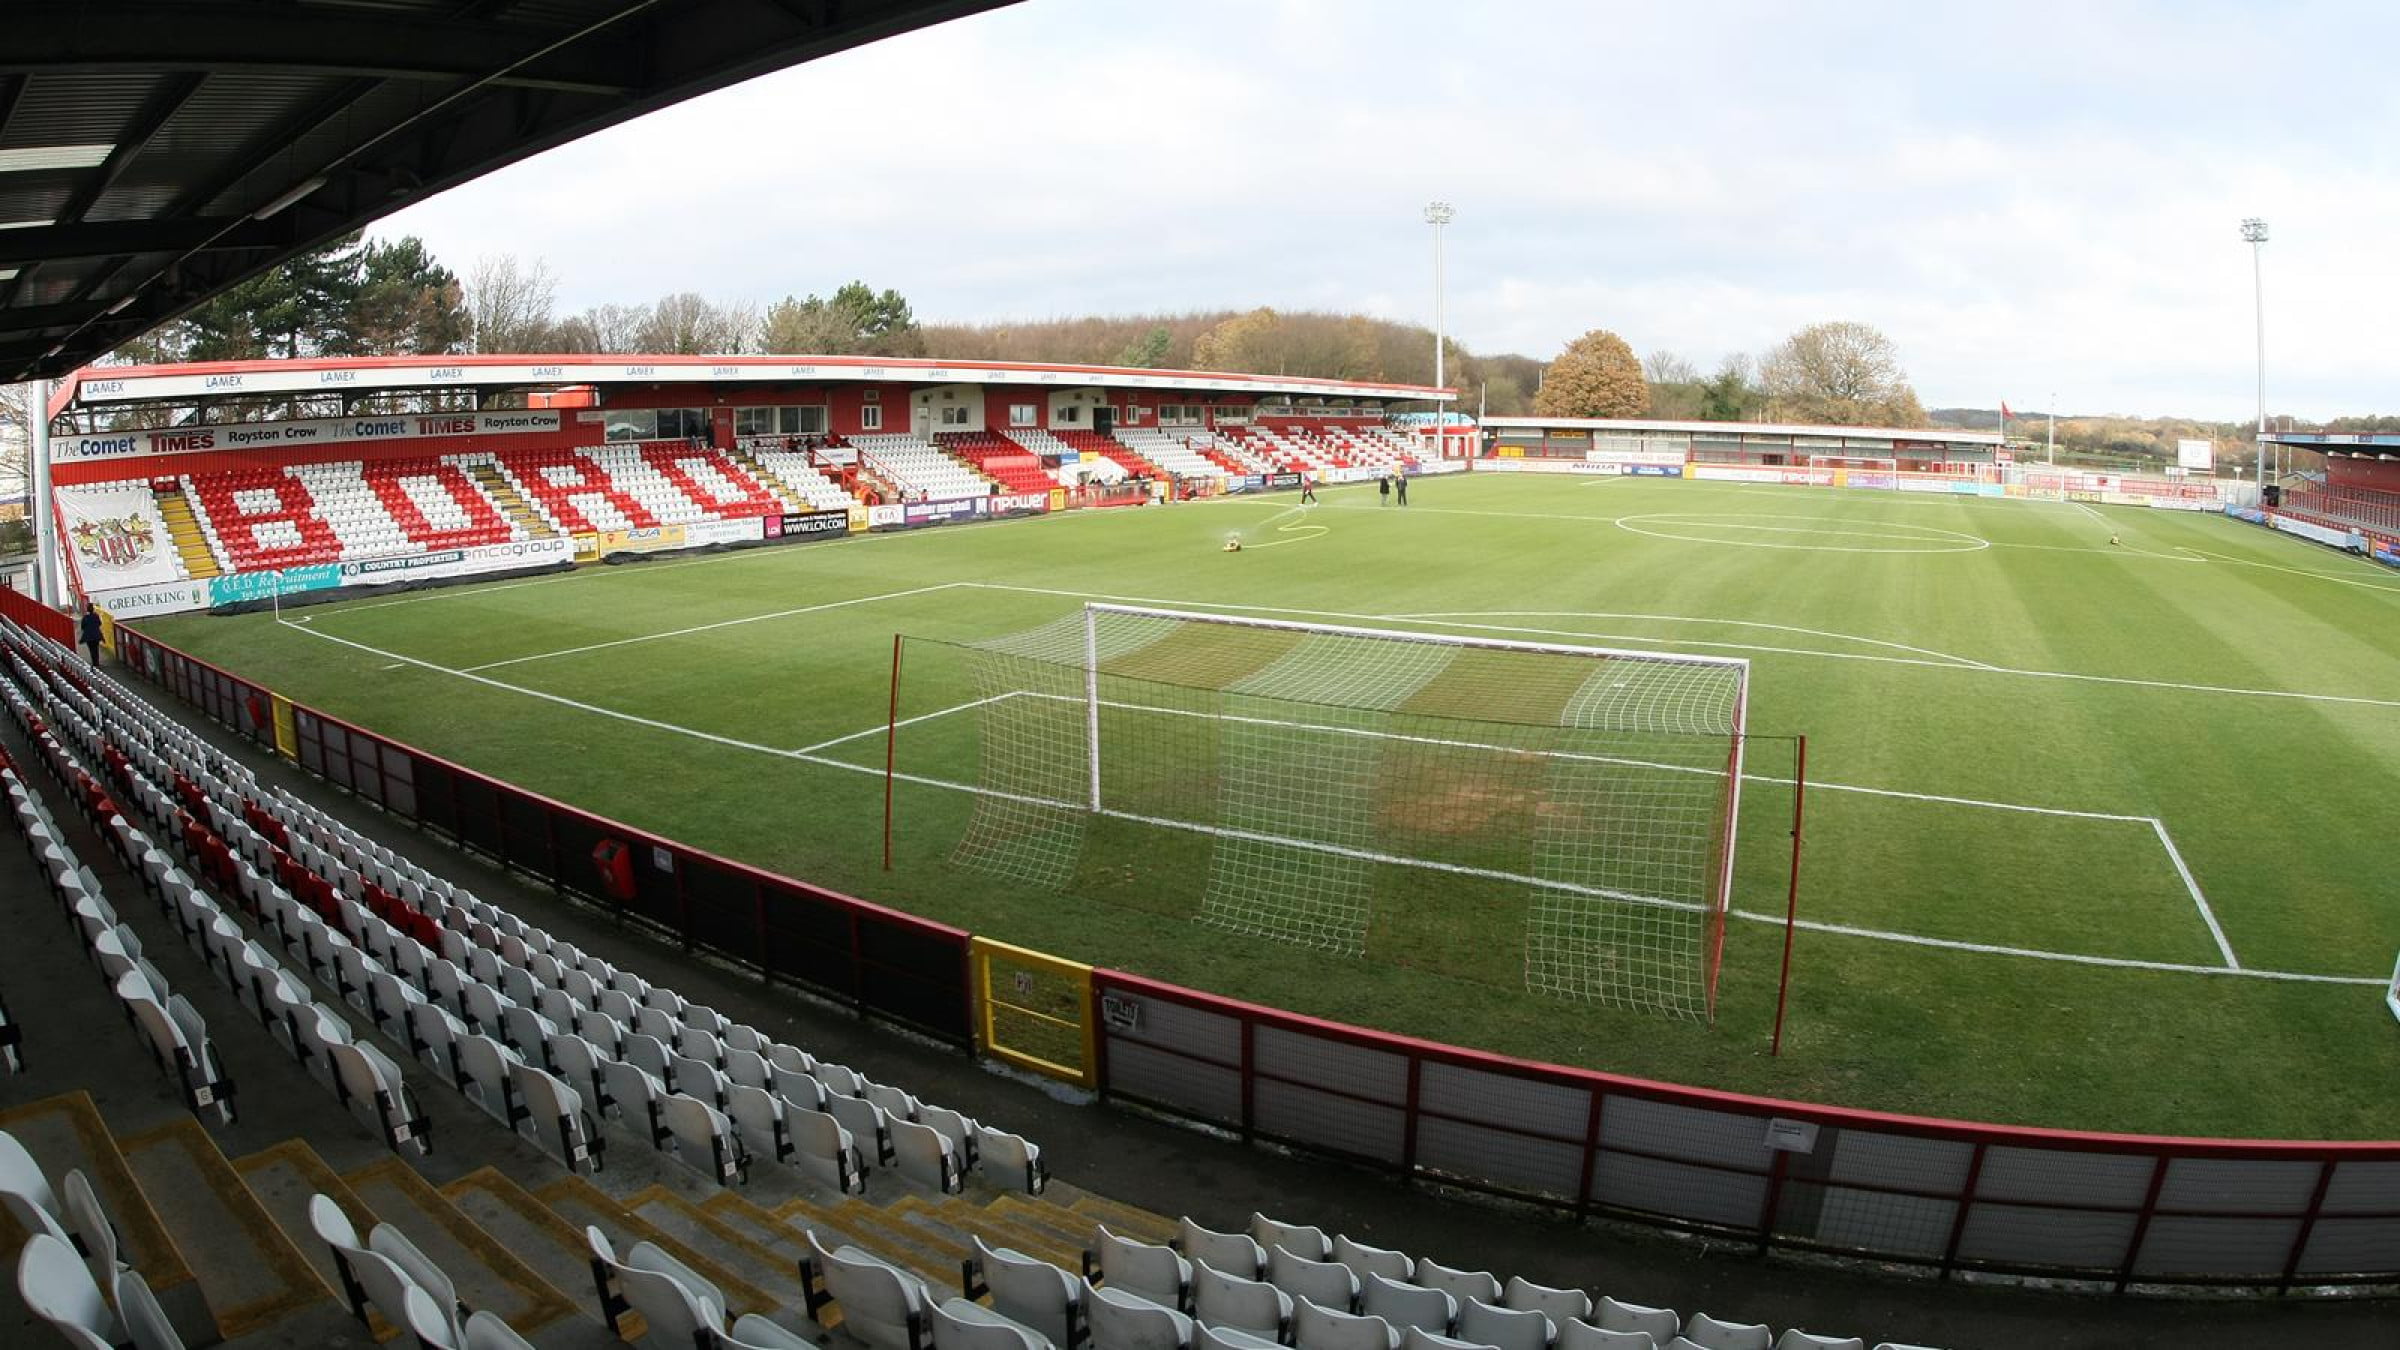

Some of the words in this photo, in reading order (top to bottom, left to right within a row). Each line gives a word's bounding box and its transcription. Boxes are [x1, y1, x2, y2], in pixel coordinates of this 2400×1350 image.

[320, 371, 356, 383] LAMEX
[431, 368, 463, 379] LAMEX
[532, 367, 562, 377] LAMEX
[626, 366, 654, 376] LAMEX
[713, 366, 739, 376] LAMEX
[791, 365, 816, 375] LAMEX
[87, 381, 124, 395] LAMEX
[206, 376, 242, 388] LAMEX
[331, 422, 356, 438] The
[355, 419, 406, 436] Comet
[415, 416, 476, 434] TIMES
[485, 417, 529, 429] Royston
[530, 416, 558, 426] Crow
[147, 431, 215, 452] TIMES
[229, 430, 280, 444] Royston
[285, 426, 317, 439] Crow
[55, 442, 80, 459] The
[80, 436, 136, 456] Comet
[991, 494, 1048, 513] npower
[627, 527, 661, 540] PJA
[784, 519, 846, 535] WWW.LCN.COM
[365, 559, 406, 571] COUNTRY
[407, 552, 460, 567] PROPERTIES
[108, 595, 153, 610] GREENE
[155, 590, 185, 605] KING
